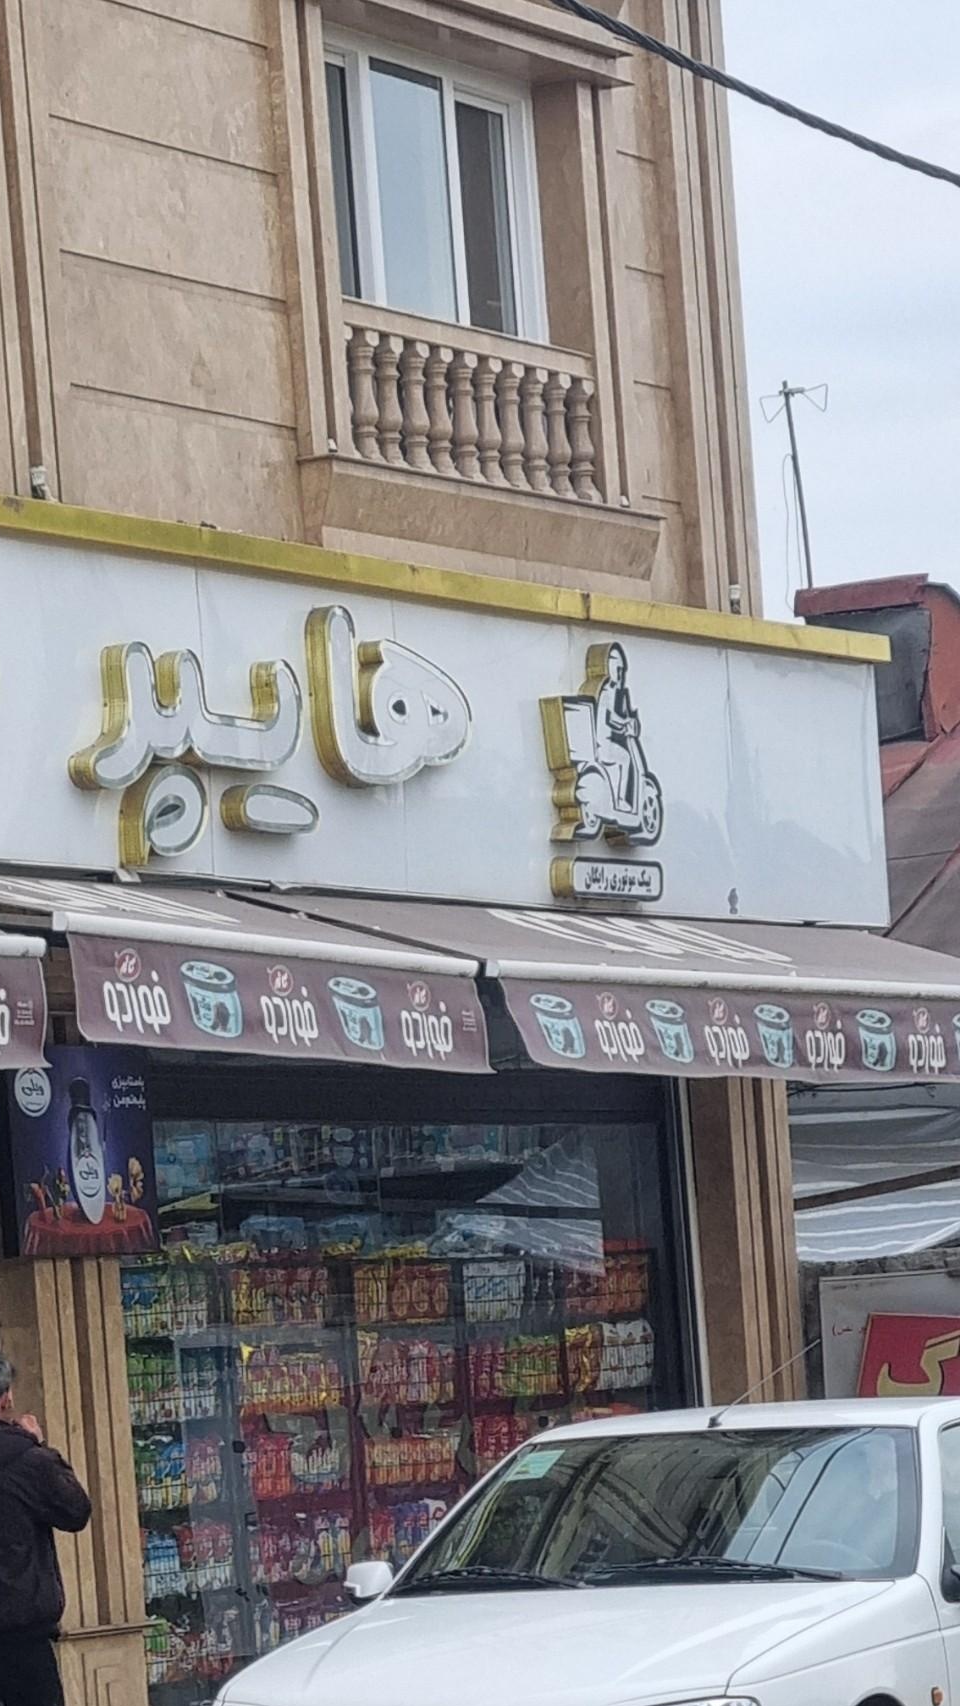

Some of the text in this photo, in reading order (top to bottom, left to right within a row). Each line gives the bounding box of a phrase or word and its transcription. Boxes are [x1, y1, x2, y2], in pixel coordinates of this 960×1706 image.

[68, 604, 473, 868] هایپر
[585, 866, 652, 893] پیک موتوری رایگان
